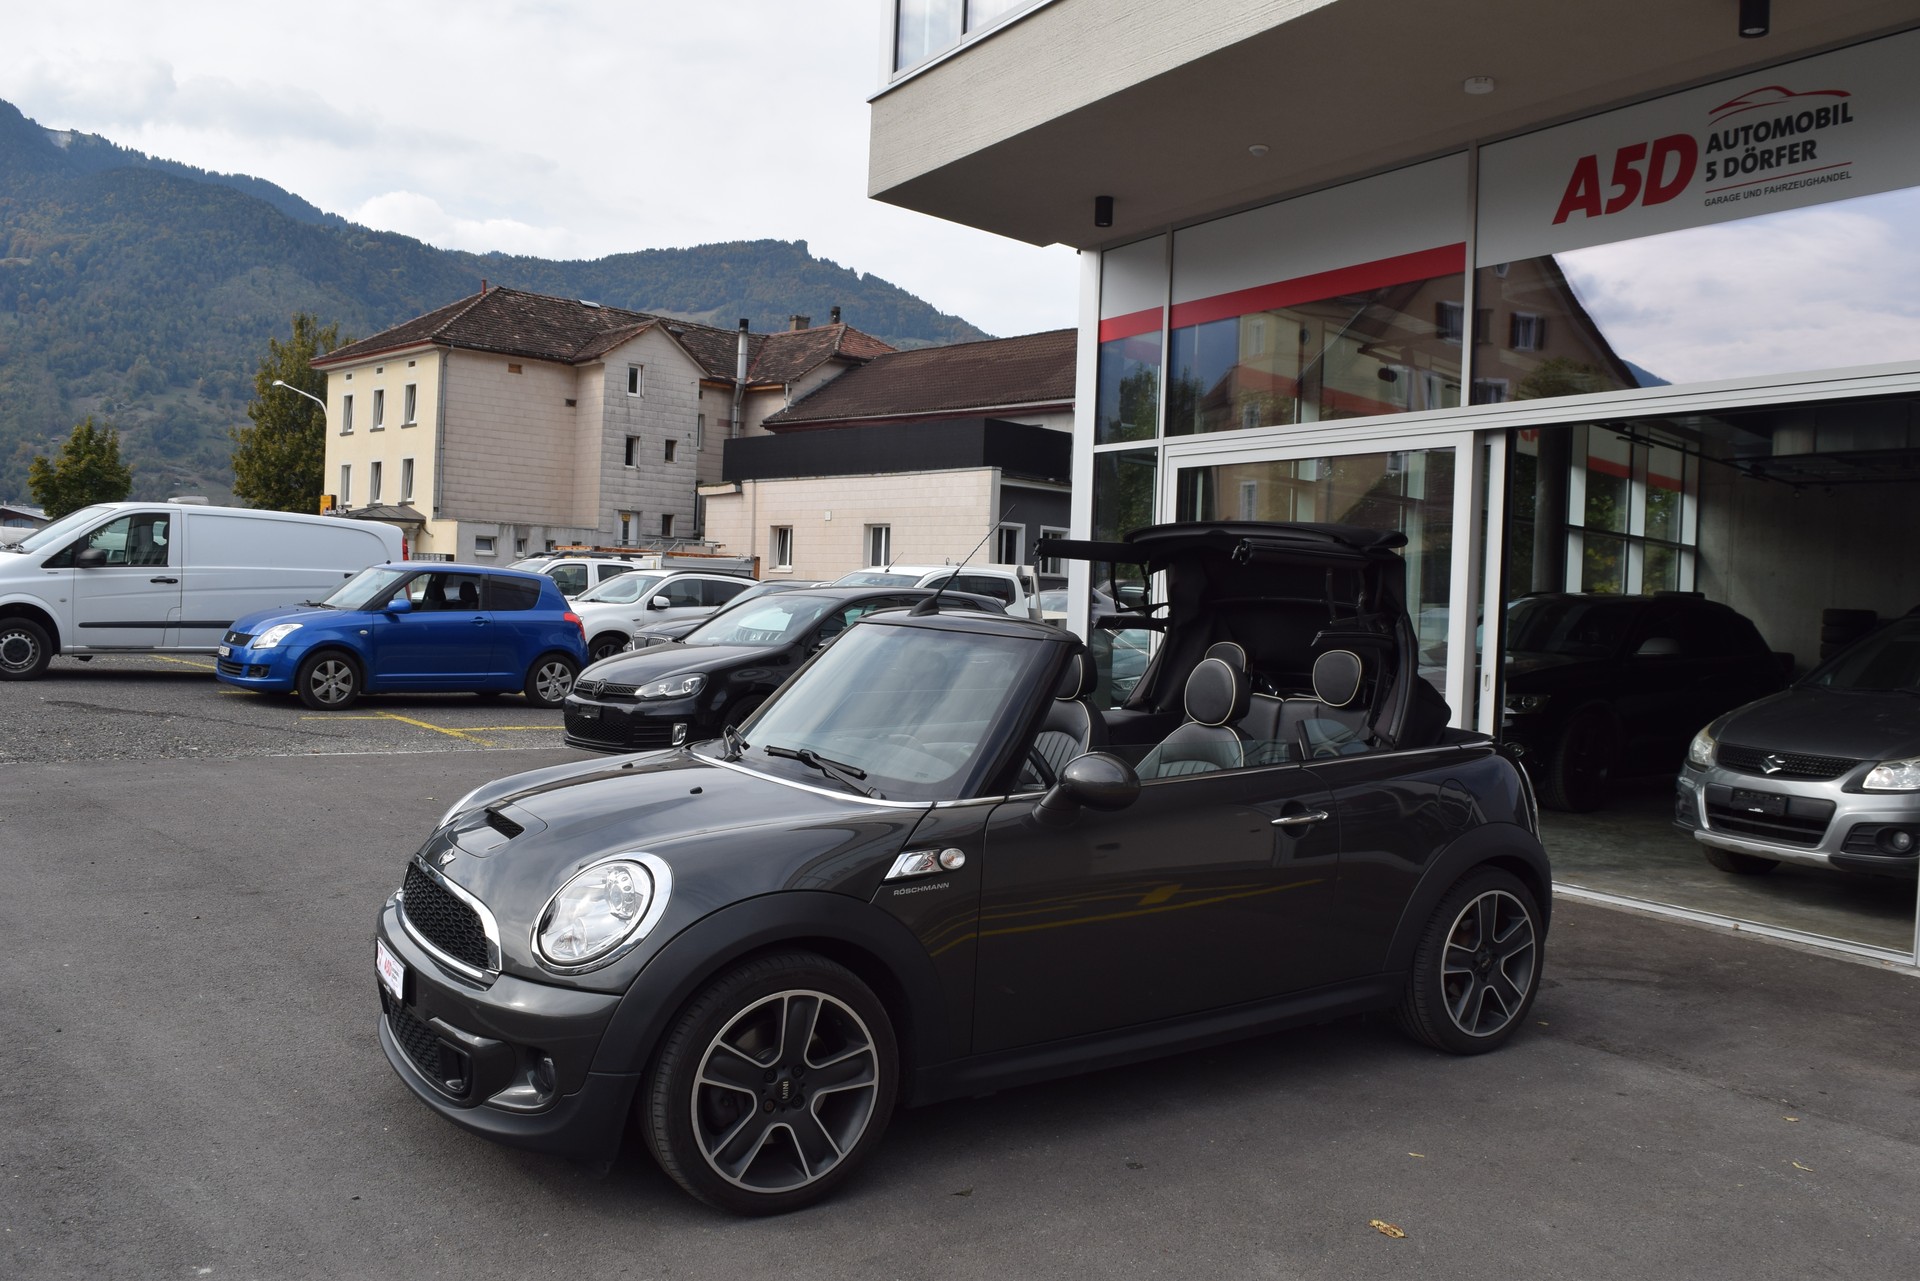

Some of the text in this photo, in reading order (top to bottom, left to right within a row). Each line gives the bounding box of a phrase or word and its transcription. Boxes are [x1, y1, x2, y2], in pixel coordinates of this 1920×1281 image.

[1706, 102, 1853, 154] AUTOMOBIL
[1552, 133, 1698, 225] A5D
[1705, 139, 1817, 183] 5 DÖRFER
[1704, 171, 1852, 207] GARAGE UND FAHRZEUGHANDEL
[893, 882, 950, 896] RÖSCHMANN
